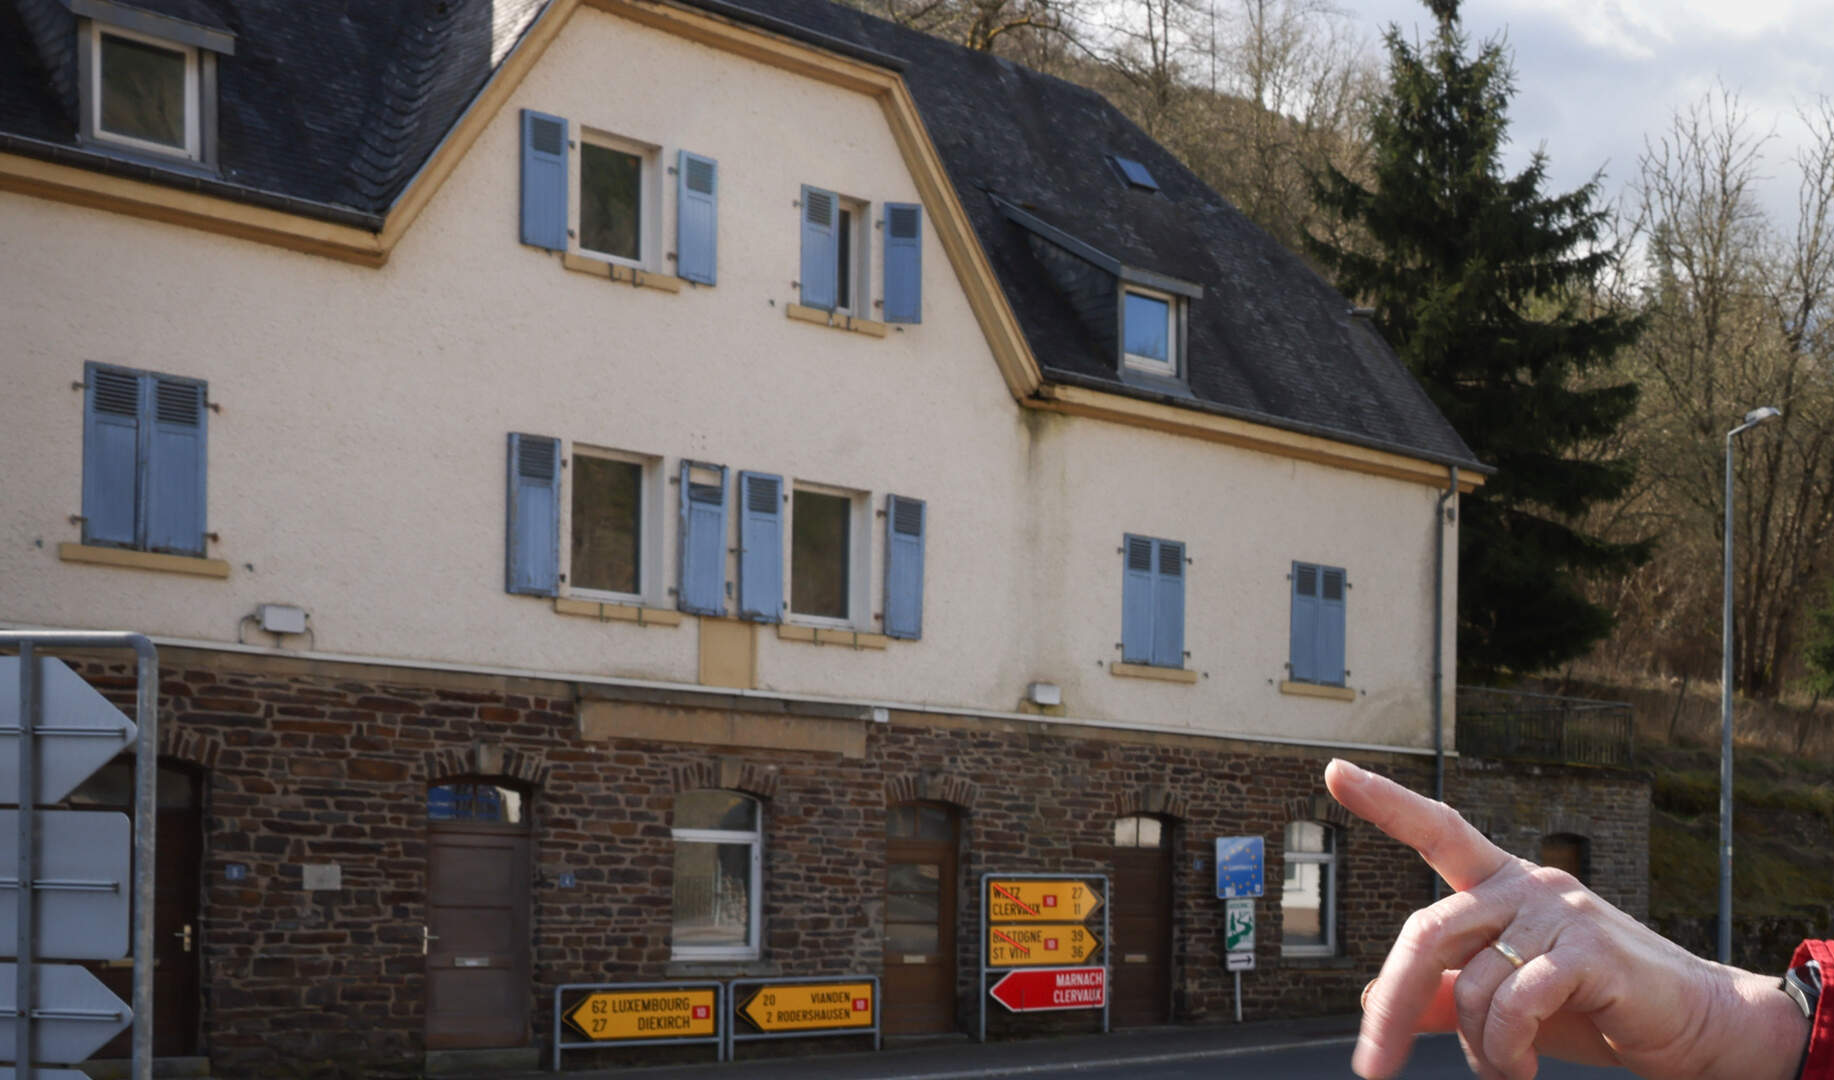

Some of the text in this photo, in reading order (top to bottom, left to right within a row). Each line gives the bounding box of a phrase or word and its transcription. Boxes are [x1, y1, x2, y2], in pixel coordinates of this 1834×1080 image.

[1072, 887, 1084, 899] 27
[992, 903, 1041, 916] CLERVAUX
[1072, 929, 1084, 942] 39
[1056, 972, 1102, 987] MARNACH
[763, 992, 850, 1006] 20 VIANDEN
[1053, 988, 1101, 1003] CLERVAUX
[592, 997, 690, 1014] 62 LUXEMBOURG
[766, 1008, 850, 1023] 2 RODERSHAUSEN
[592, 1016, 690, 1033] 27 DIEKIRCH
